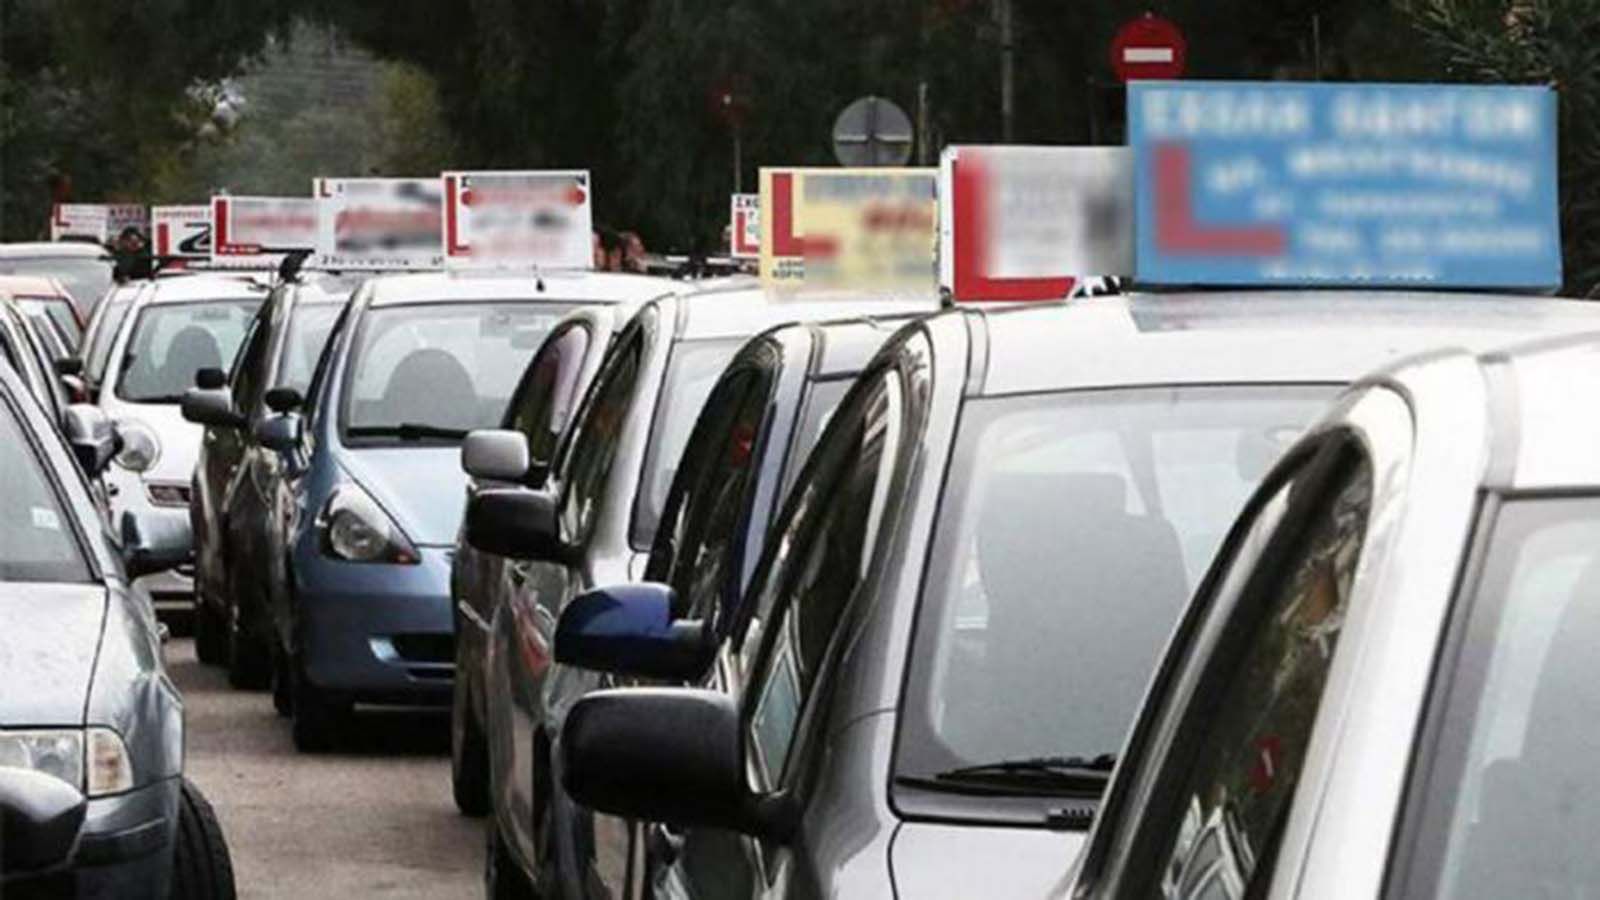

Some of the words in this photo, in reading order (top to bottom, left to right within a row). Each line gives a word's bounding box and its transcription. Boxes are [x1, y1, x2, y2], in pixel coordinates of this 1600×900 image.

[55, 202, 70, 227] L
[319, 180, 332, 197] L
[446, 176, 471, 256] L
[772, 173, 838, 256] L
[215, 199, 262, 255] L
[736, 211, 759, 253] L
[952, 155, 1076, 302] L
